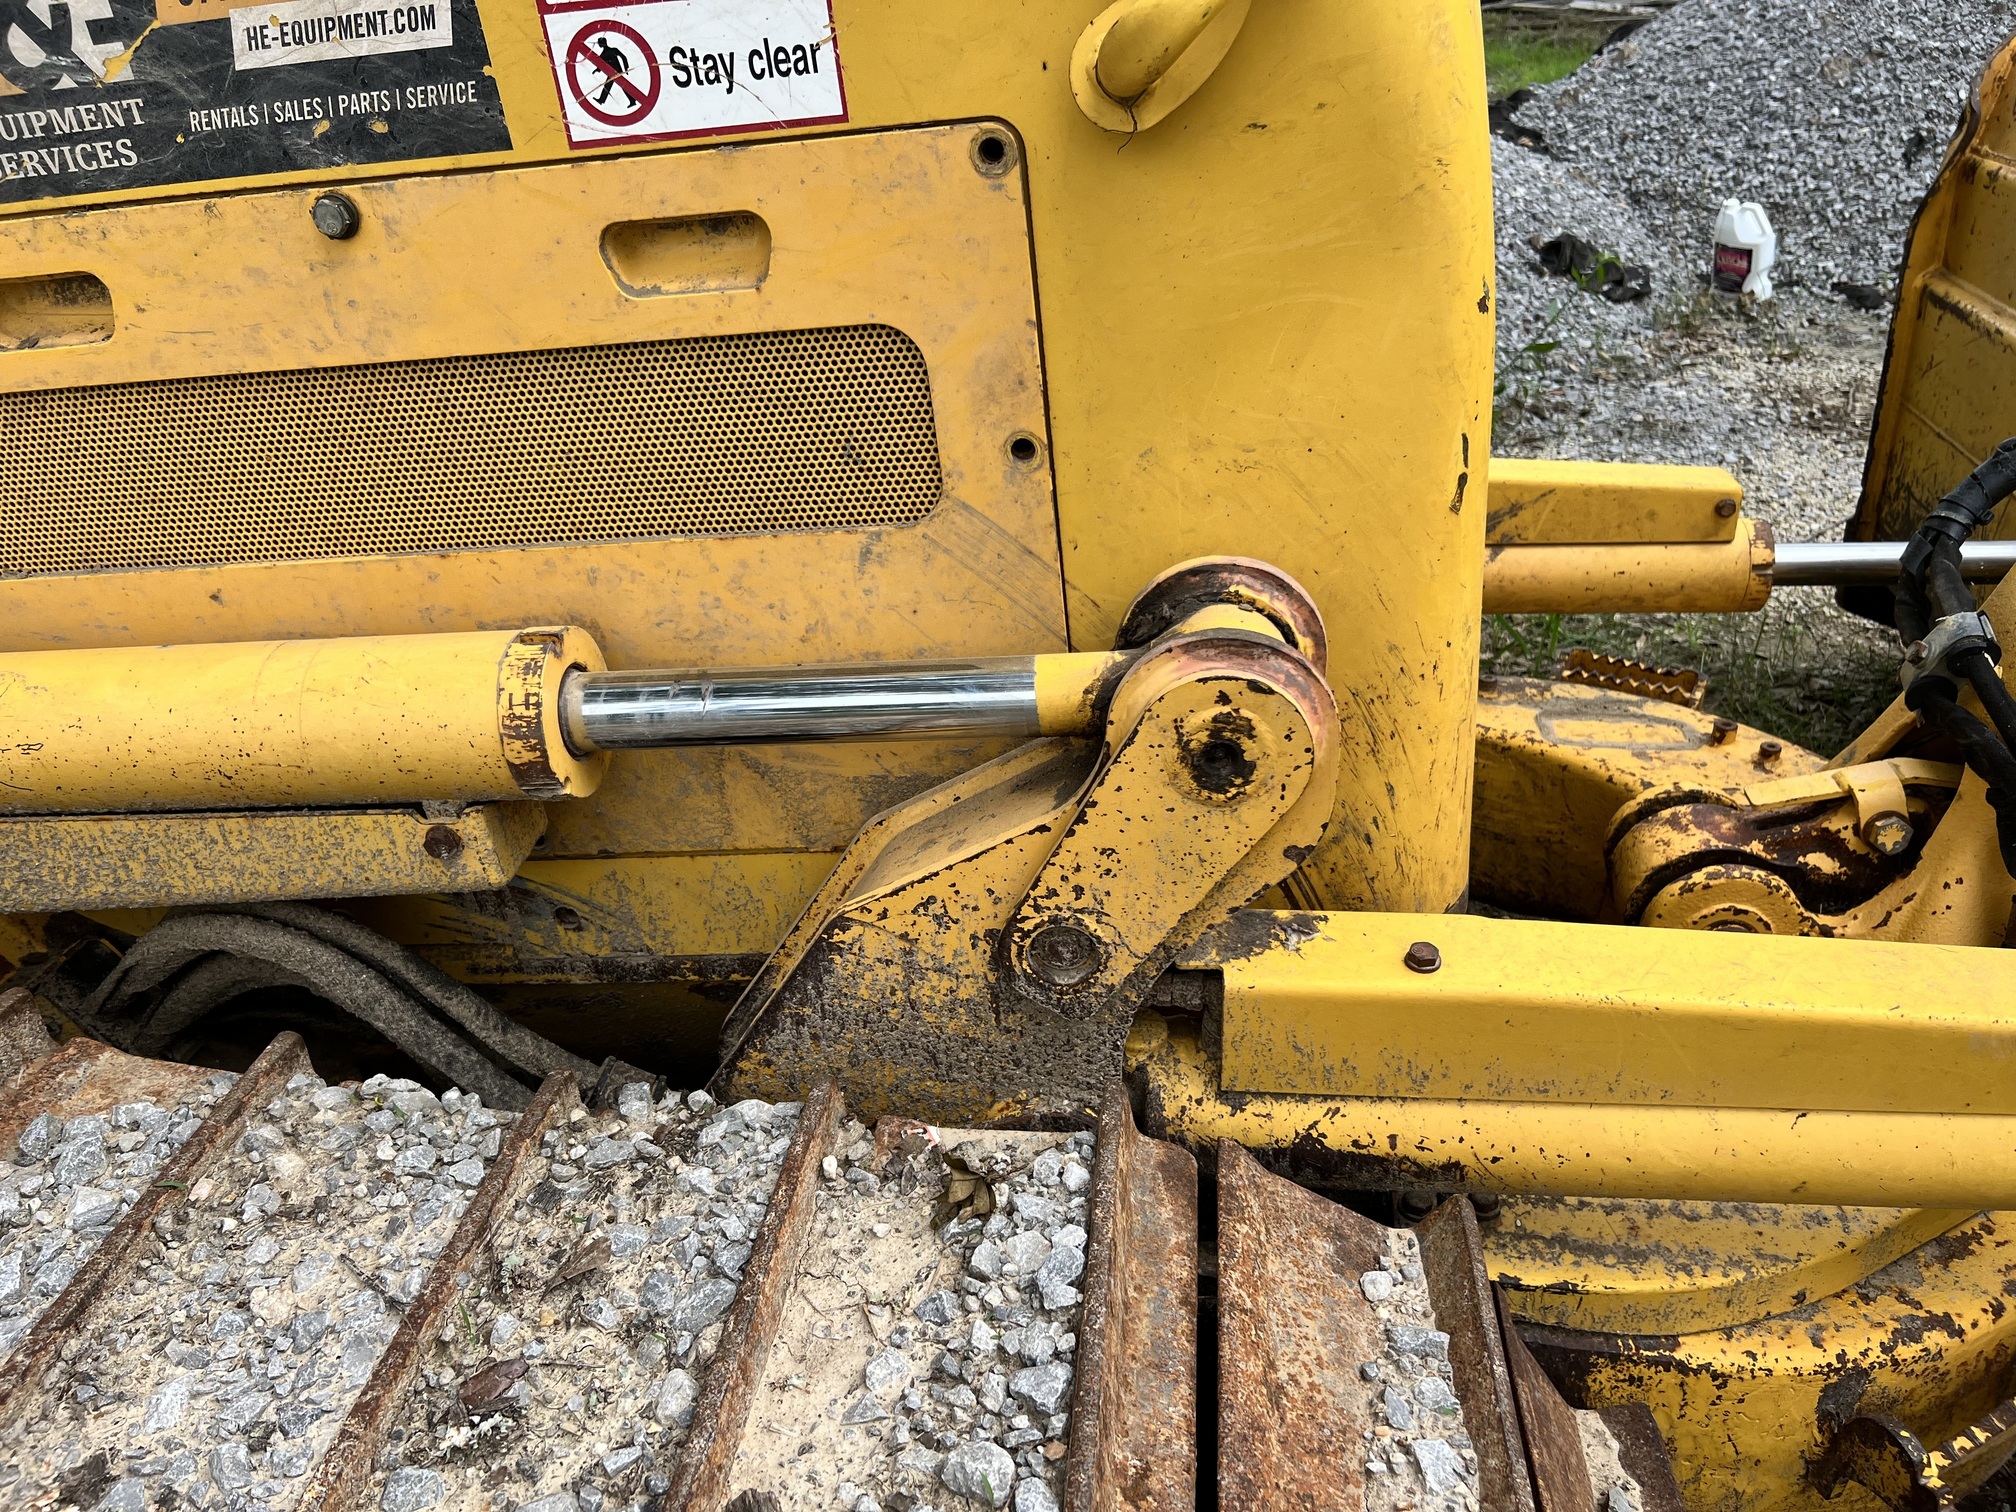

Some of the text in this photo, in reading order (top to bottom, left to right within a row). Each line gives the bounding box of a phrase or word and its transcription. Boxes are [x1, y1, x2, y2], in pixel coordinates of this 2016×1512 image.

[246, 4, 436, 51] HE-EQUIPMENT.COM
[669, 37, 821, 95] Stay clear
[189, 104, 259, 132] RENTALS
[273, 97, 323, 124] SALES
[339, 88, 391, 116] PARTS
[406, 80, 478, 109] SERVICE
[0, 138, 138, 180] ERVICES
